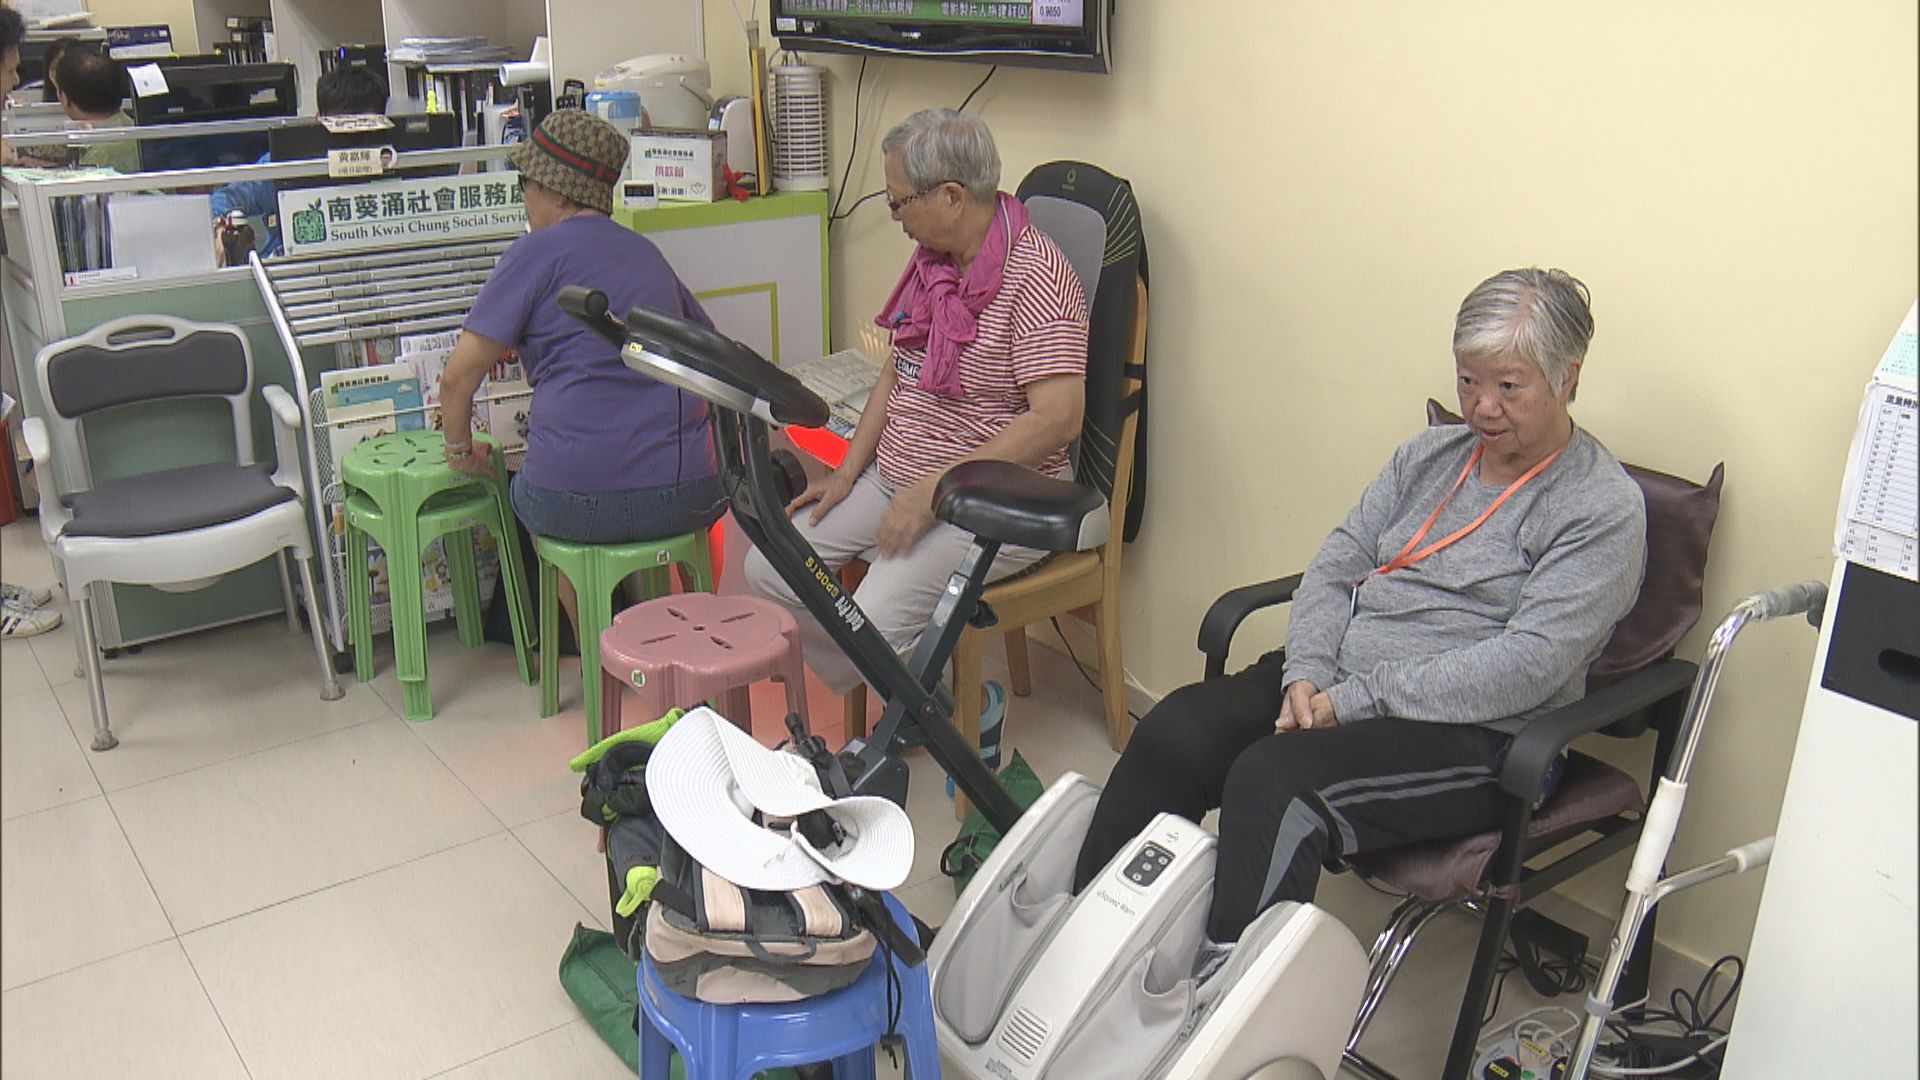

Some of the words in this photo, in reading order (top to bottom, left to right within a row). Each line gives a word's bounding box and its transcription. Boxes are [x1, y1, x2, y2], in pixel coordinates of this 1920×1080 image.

[327, 183, 524, 222] 南葵涌社會服務處
[331, 226, 368, 241] South
[372, 222, 404, 237] Kwai
[408, 220, 450, 233] Chung
[452, 214, 488, 229] Social
[805, 555, 839, 598] SPORTS
